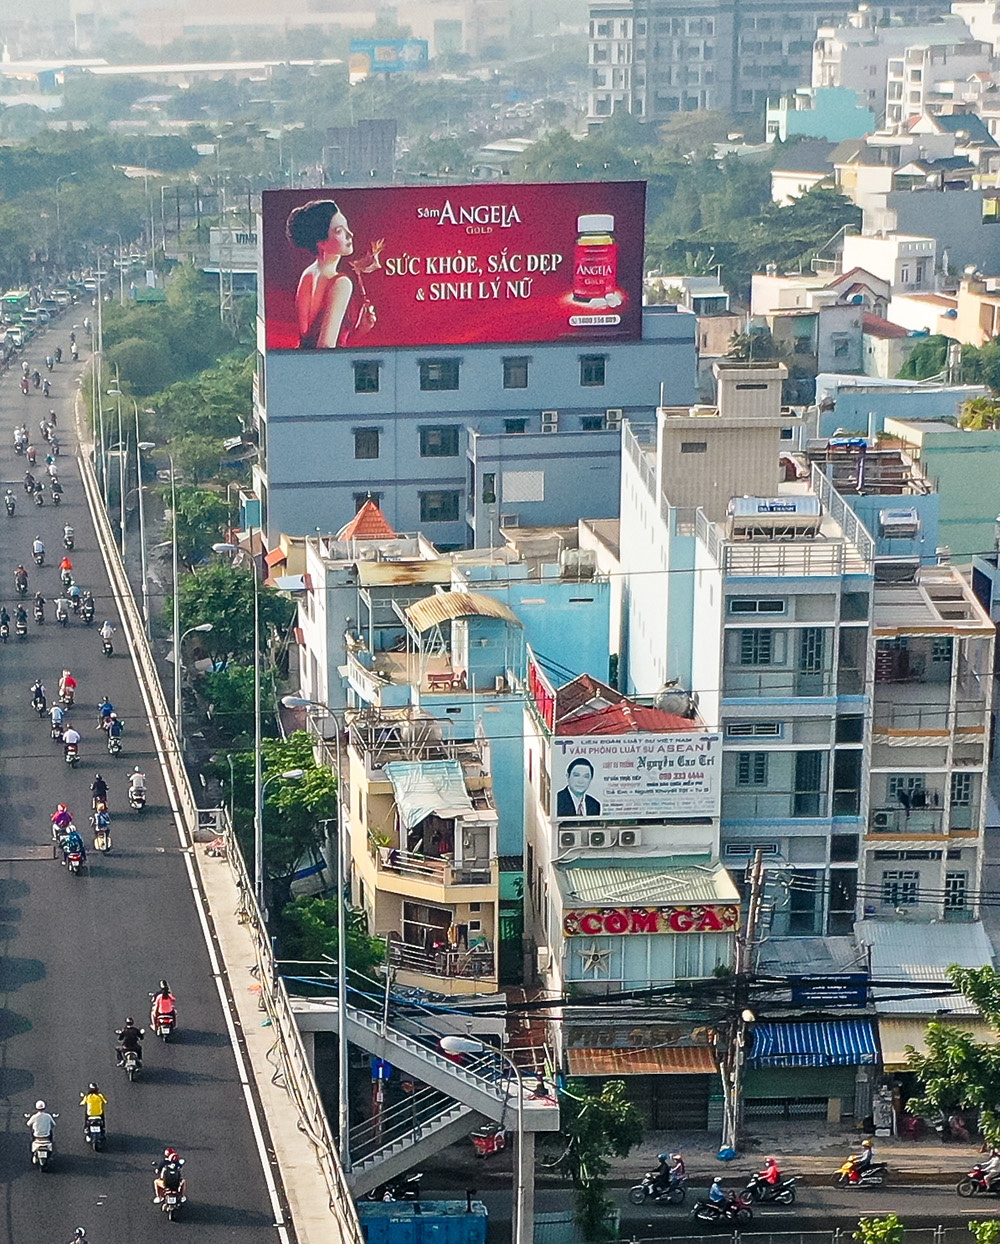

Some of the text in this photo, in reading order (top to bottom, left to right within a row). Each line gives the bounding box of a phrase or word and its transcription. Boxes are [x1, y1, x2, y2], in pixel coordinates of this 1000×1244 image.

[437, 200, 522, 228] ANGELA
[466, 226, 493, 234] GOLD
[386, 248, 563, 278] SỨC KHỎE, SẮC ĐẸP
[576, 264, 612, 276] ANGELA
[415, 278, 534, 301] & SINH LÝ NỮ
[588, 745, 617, 755] PHÒNG
[657, 743, 705, 753] ASEAN
[637, 755, 674, 772] Nguyễn
[677, 756, 696, 767] Cao
[669, 904, 723, 932] GÀ
